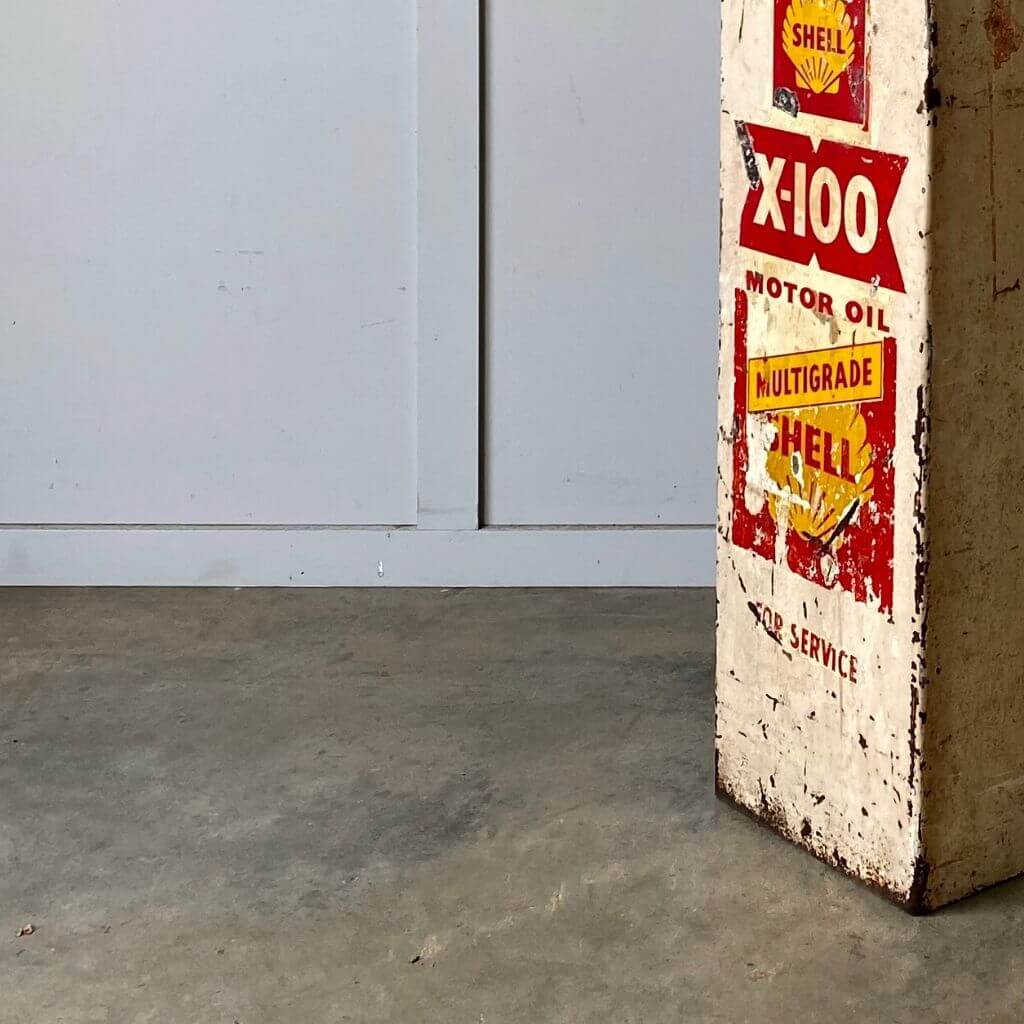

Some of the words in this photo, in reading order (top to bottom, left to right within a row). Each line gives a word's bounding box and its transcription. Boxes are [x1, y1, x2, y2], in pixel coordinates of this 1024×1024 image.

[792, 23, 846, 54] SHELL
[752, 152, 878, 255] X-100
[746, 270, 834, 316] MOTOR
[845, 301, 890, 333] OIL
[756, 357, 873, 399] MULTIGRADE
[753, 601, 784, 643] OR
[790, 623, 858, 684] SERVICE
